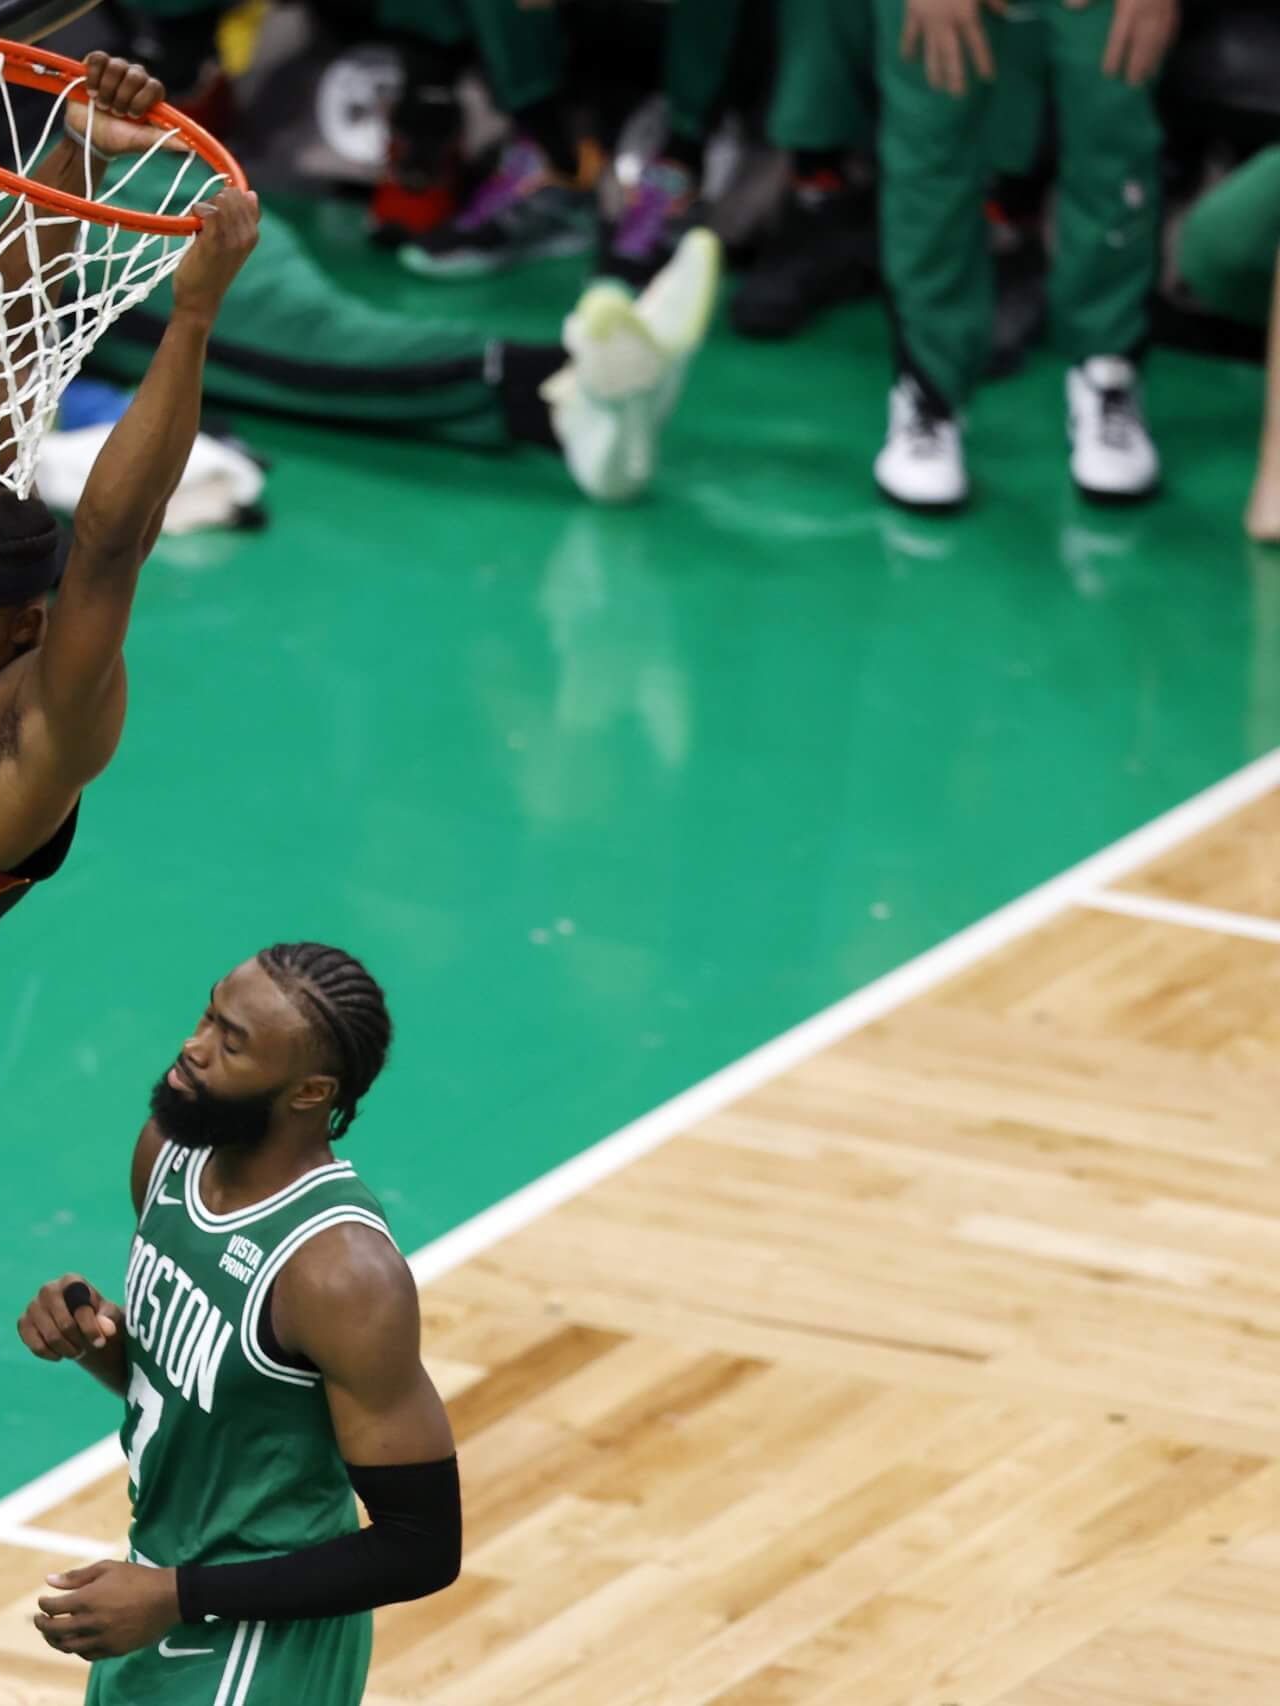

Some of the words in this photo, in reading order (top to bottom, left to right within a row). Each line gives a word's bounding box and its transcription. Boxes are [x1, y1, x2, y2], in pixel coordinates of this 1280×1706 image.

[172, 1146, 190, 1172] 6
[219, 1253, 255, 1285] PRINT
[227, 1234, 264, 1271] VISTA
[126, 1361, 164, 1492] 7
